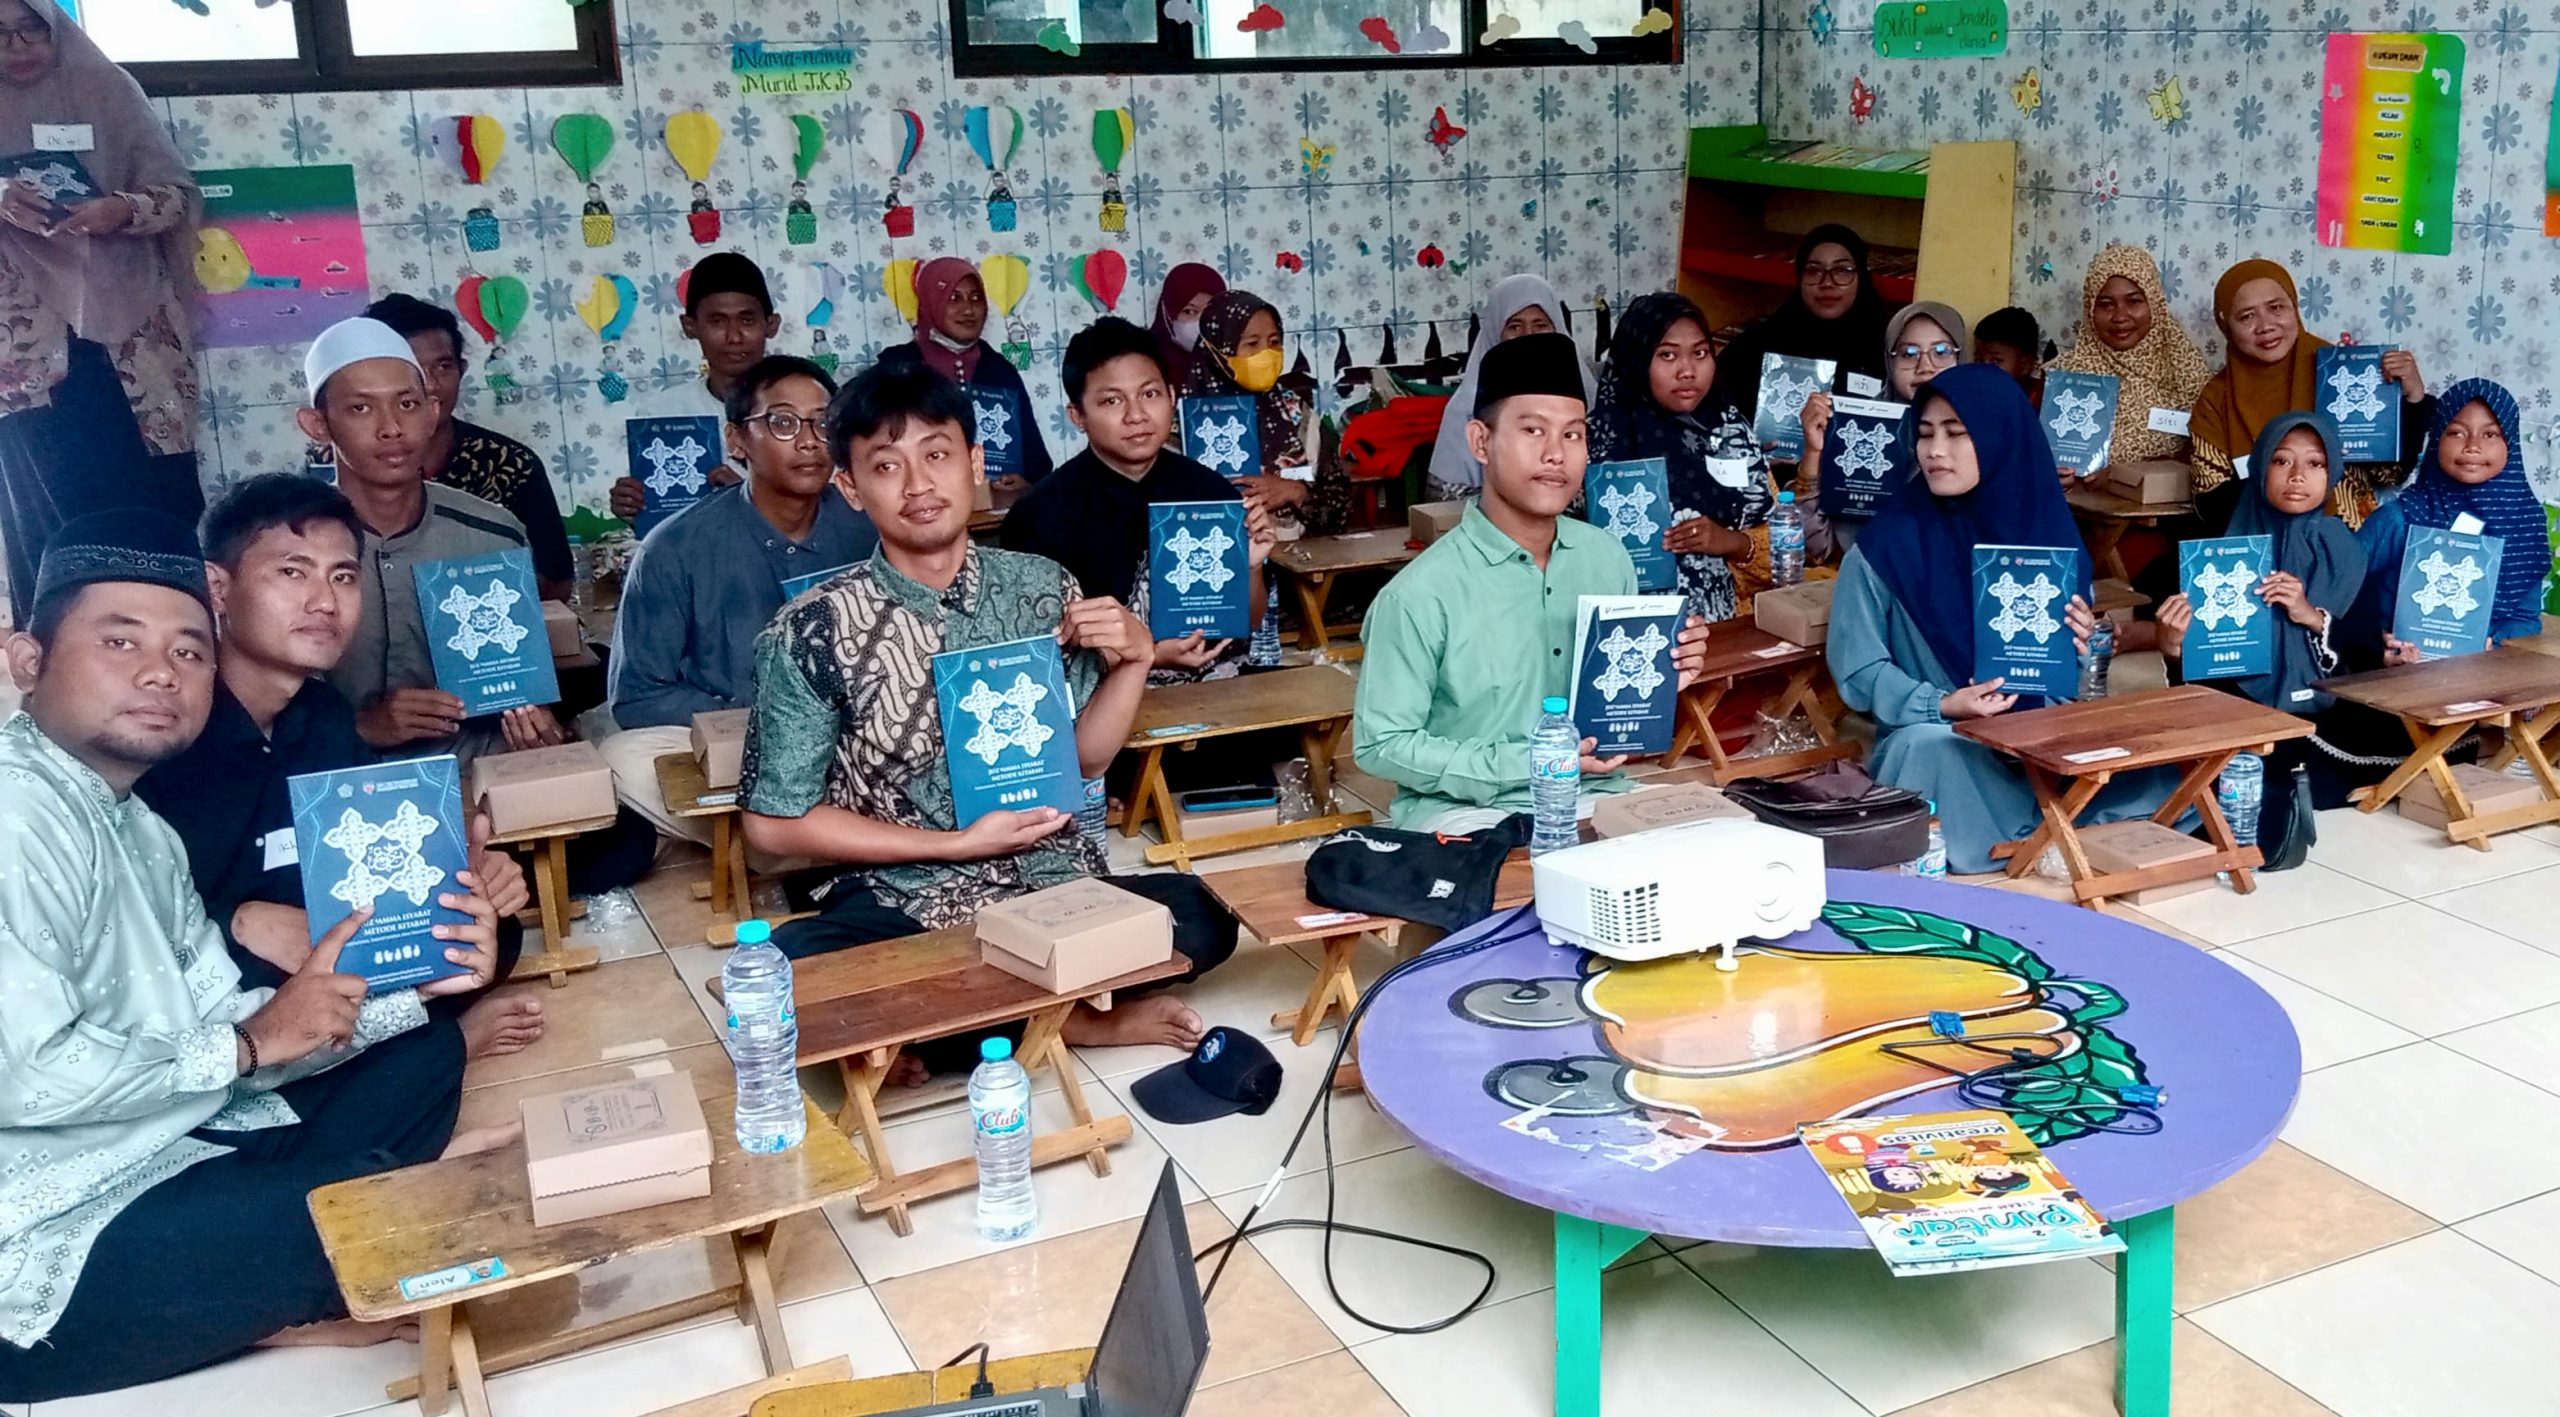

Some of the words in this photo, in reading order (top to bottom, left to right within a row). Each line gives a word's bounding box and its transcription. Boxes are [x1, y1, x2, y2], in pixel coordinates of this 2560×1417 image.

[741, 71, 799, 93] Murid
[981, 1107, 1019, 1128] Club
[1882, 1124, 2006, 1145] Kreativitas
